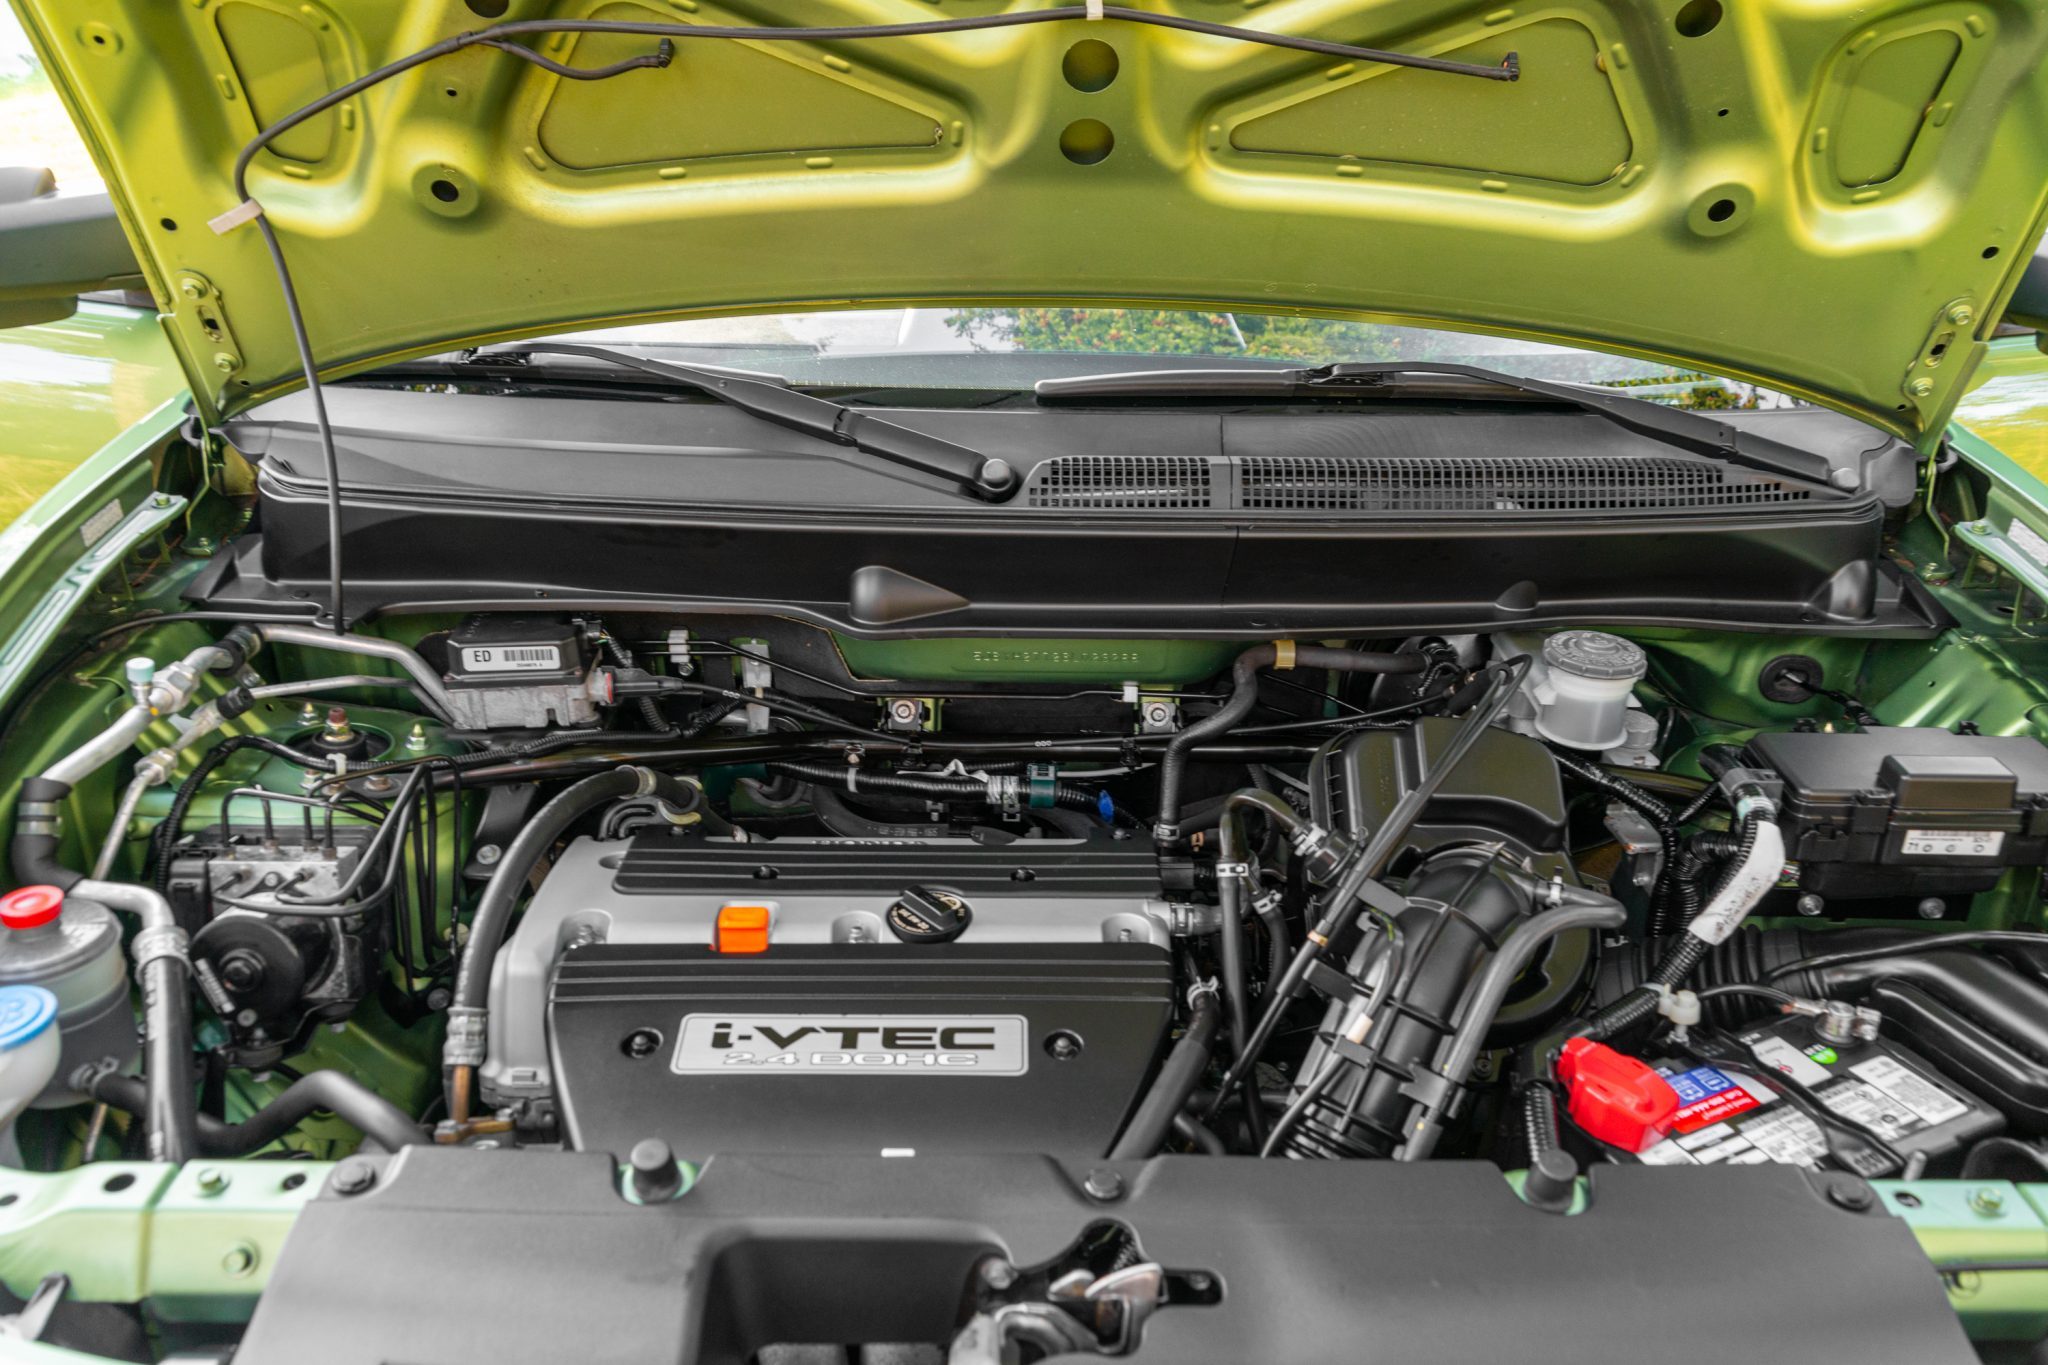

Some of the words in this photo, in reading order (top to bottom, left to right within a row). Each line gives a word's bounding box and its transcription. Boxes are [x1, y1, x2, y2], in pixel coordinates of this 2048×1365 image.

[473, 650, 491, 662] ED
[711, 1022, 995, 1050] i-VTEC
[723, 1052, 799, 1066] 2.4
[810, 1052, 978, 1066] DOHC
